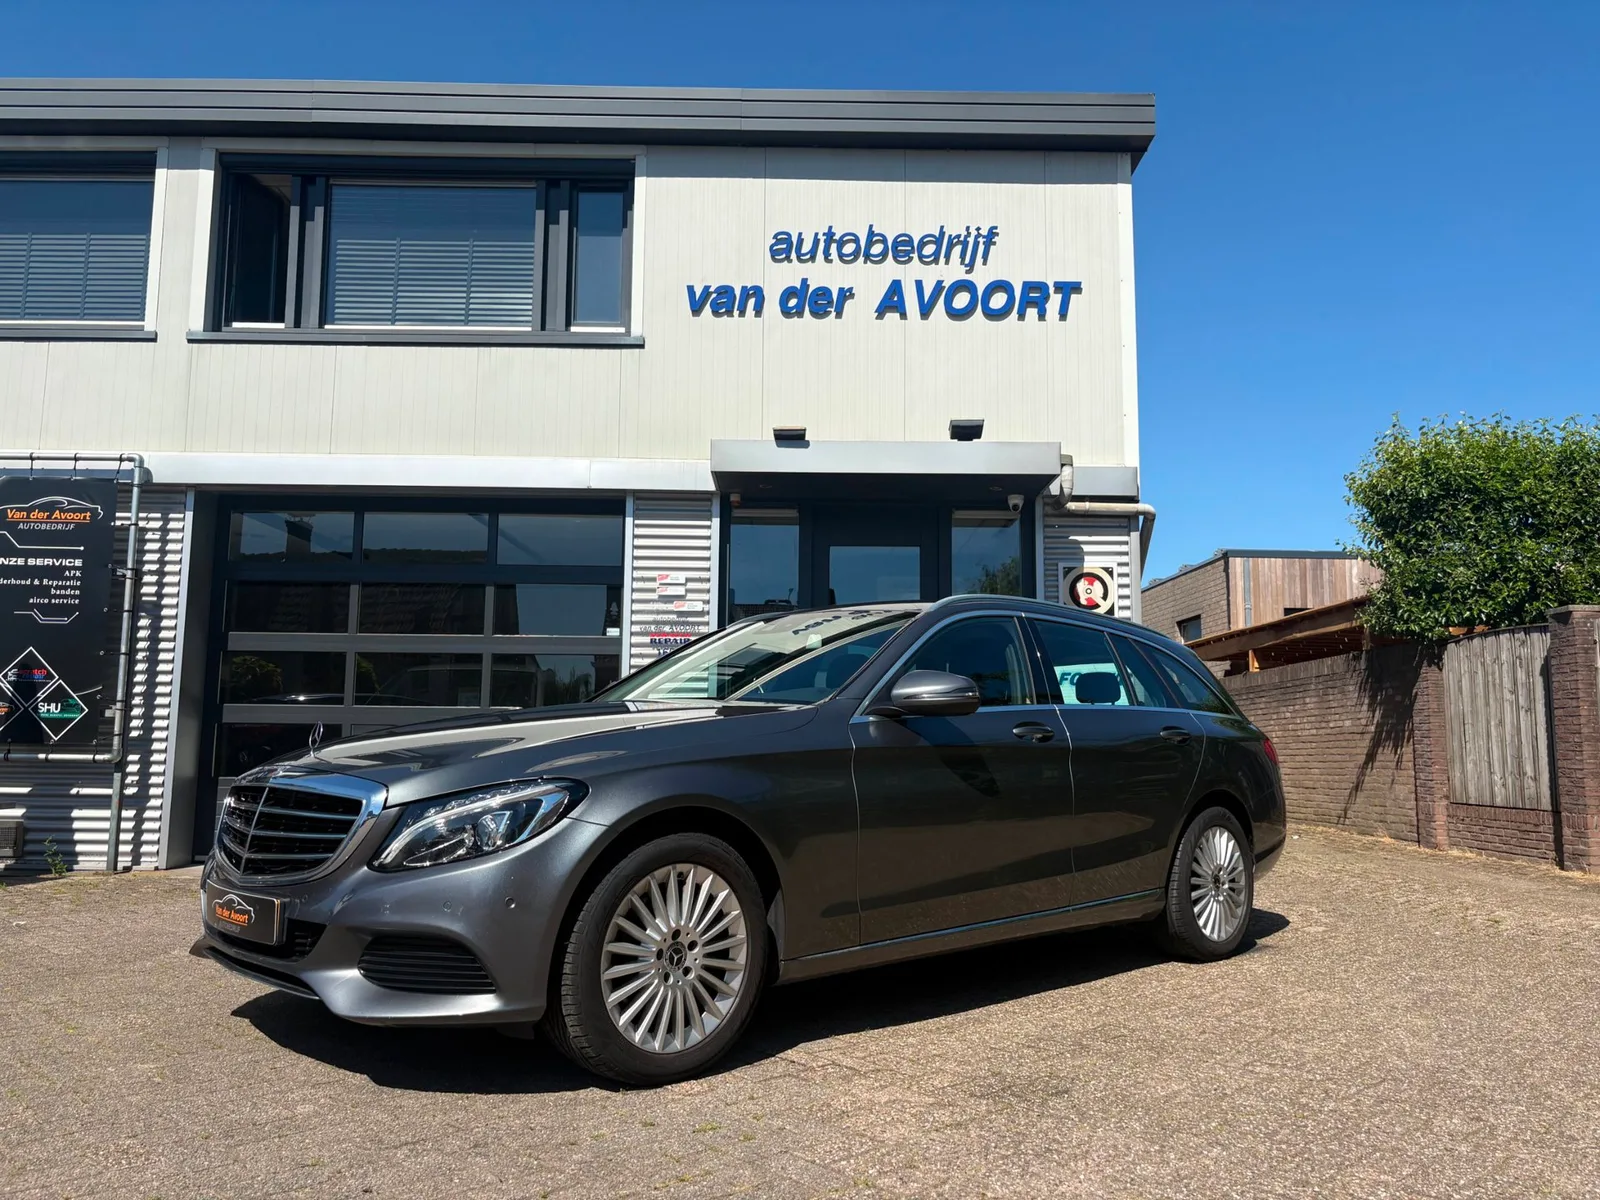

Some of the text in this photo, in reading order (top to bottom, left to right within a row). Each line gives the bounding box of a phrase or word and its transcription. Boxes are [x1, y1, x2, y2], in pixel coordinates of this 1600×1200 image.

[769, 224, 999, 273] autobedrijf
[686, 278, 1082, 322] van der AVOORT
[7, 509, 91, 520] Van der Avoort
[17, 523, 76, 531] AUTOBEDRIJF
[27, 558, 83, 567] SERVICE
[43, 579, 81, 587] Reparatie
[37, 702, 61, 713] SHU
